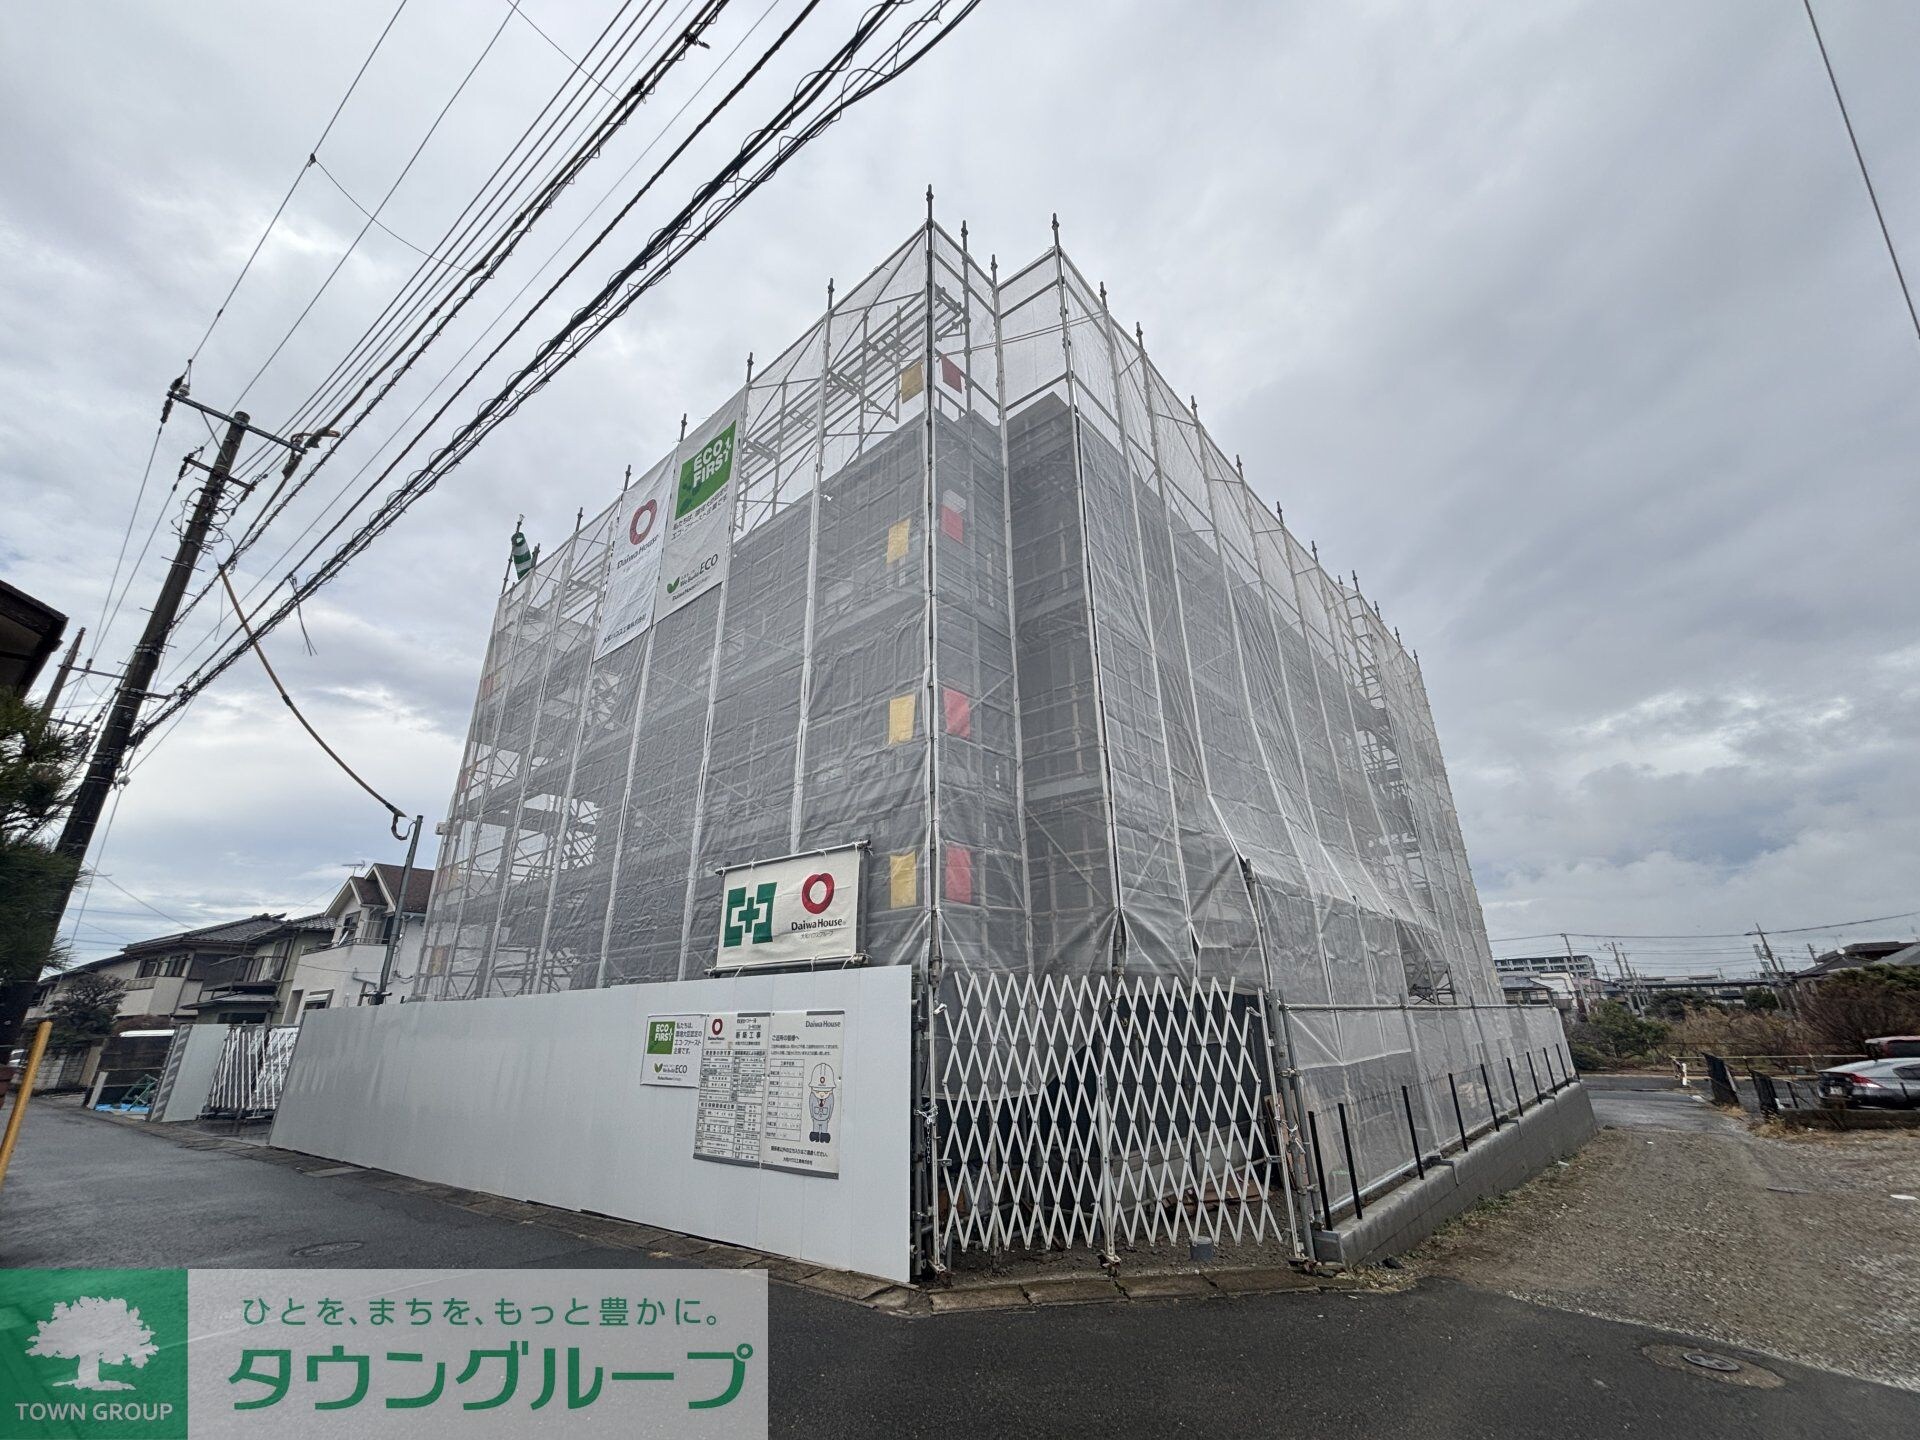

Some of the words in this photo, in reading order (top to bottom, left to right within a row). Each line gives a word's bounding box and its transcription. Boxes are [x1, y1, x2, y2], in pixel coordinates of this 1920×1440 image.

[693, 439, 723, 472] ECO
[693, 448, 729, 488] FIRST
[617, 550, 638, 570] Daiwa
[700, 553, 719, 575] ECO
[791, 920, 817, 931] Daiwa
[817, 918, 843, 928] House
[655, 1024, 670, 1033] ECO
[805, 1020, 822, 1028] Daiwa
[823, 1020, 841, 1028] House
[654, 1032, 674, 1042] FIRST
[675, 1064, 688, 1074] ECO
